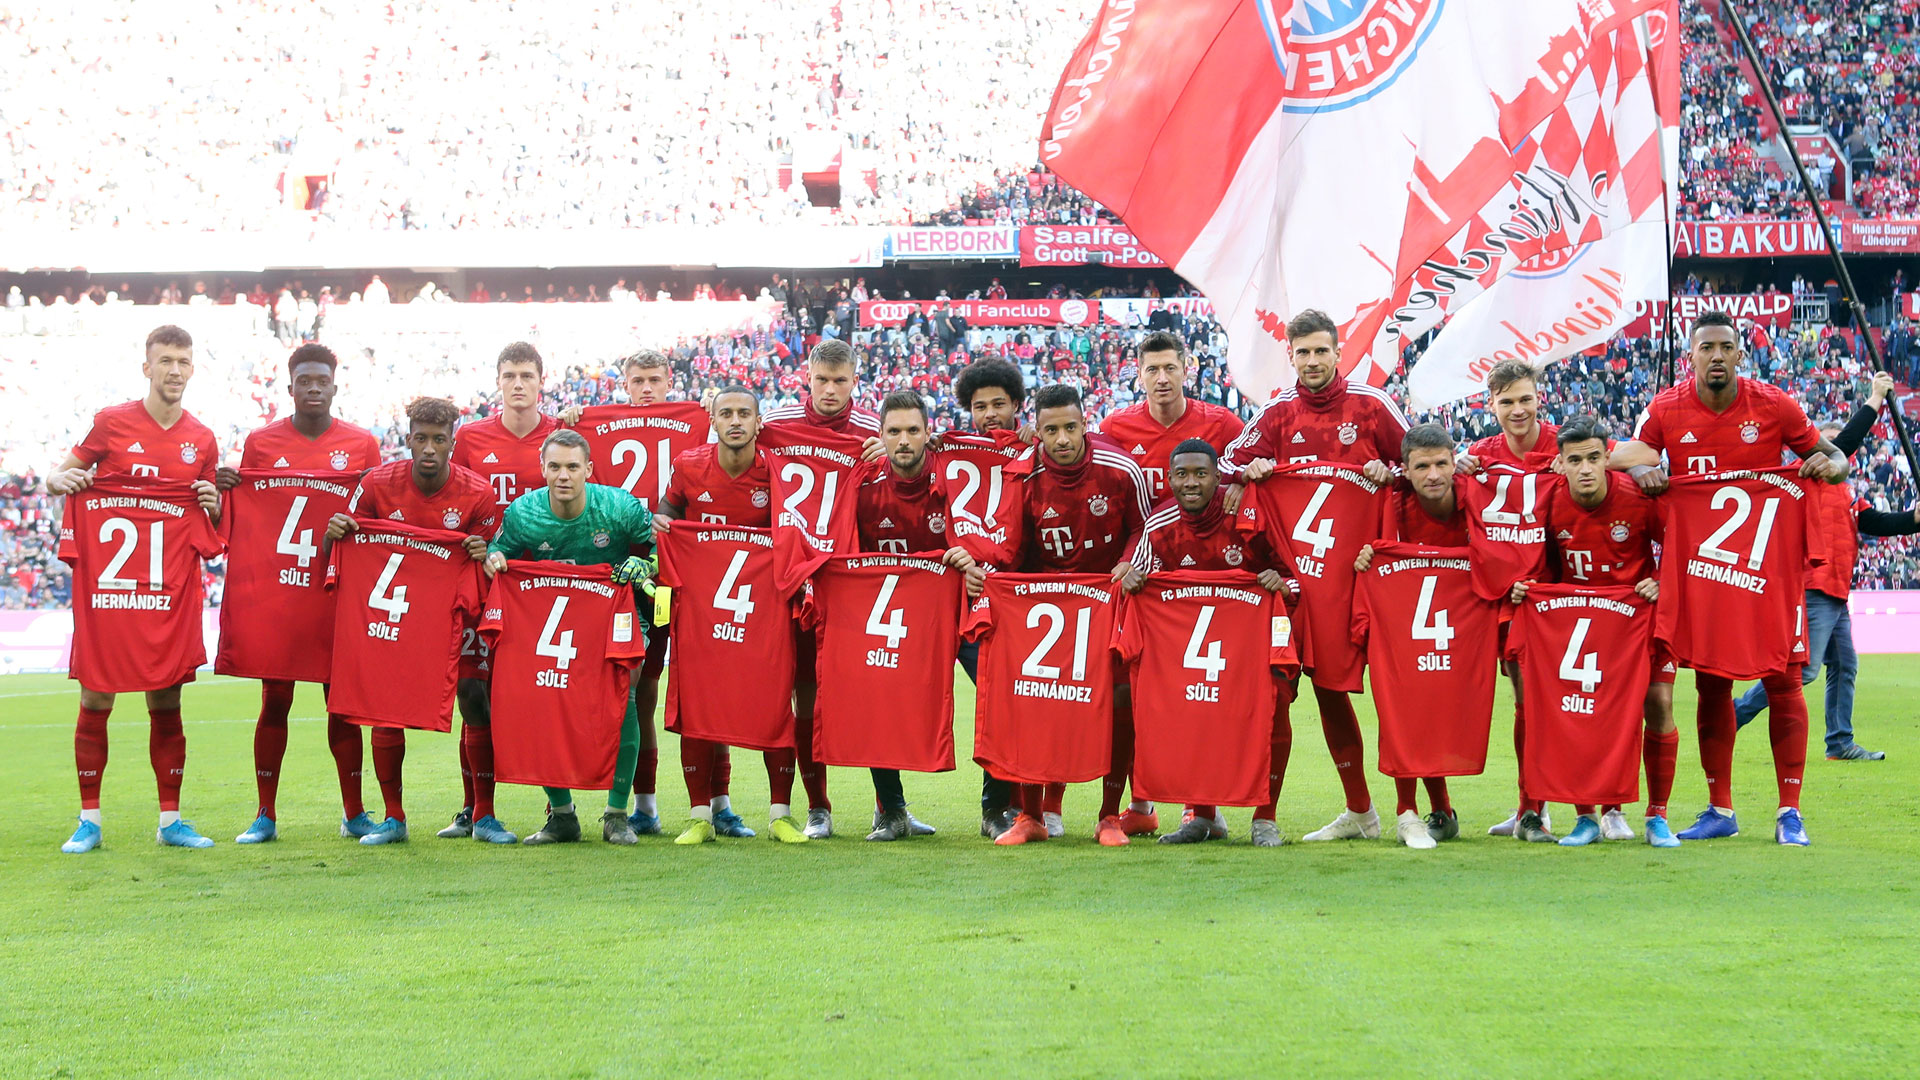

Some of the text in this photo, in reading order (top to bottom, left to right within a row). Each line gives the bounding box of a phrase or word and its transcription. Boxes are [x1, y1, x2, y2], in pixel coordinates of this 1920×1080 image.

[1704, 224, 1825, 254] BAKUM
[1852, 223, 1918, 236] Hanse Bayern
[1862, 234, 1908, 246] Lüneburg
[898, 230, 1008, 252] HERBORN
[1034, 244, 1164, 264] Grottn-Pow
[978, 304, 1050, 318] Fanclub
[596, 416, 691, 436] FC BAYERN MÜNCHEN
[814, 446, 856, 468] MÜNCHEN
[611, 438, 670, 511] 21
[1336, 466, 1378, 495] MÜNCHEN
[254, 478, 350, 498] FC BAYERN MÜNCHEN
[490, 474, 516, 504] T
[946, 460, 1003, 529] 21
[1759, 472, 1804, 500] MÜNCHEN
[86, 497, 185, 518] FC BAYERN MÜNCHEN
[780, 462, 839, 536] 21
[1292, 482, 1336, 559] 4
[1698, 486, 1780, 572] 21
[276, 496, 318, 568] 4
[697, 531, 774, 548] FC BAYERN MÜNC
[1041, 526, 1074, 558] T
[1486, 526, 1546, 544] ERNÁNDEZ
[98, 517, 164, 592] 21
[355, 533, 452, 560] FC BAYERN MÜNCHEN
[847, 557, 946, 576] FC BAYERN MÜNCHEN
[1295, 556, 1325, 578] SÜLE
[1378, 558, 1472, 577] FC BAYERN MÜNCHE
[1566, 550, 1593, 581] T
[279, 568, 311, 588] SÜLE
[368, 552, 410, 624] 4
[520, 577, 615, 599] FC BAYERN MÜNCHEN
[712, 550, 756, 624] 4
[1687, 559, 1767, 595] HERNÁNDEZ
[92, 590, 172, 612] HERNÁNDEZ
[1014, 582, 1112, 604] FC BAYERN MÜNCHEN
[1162, 586, 1262, 606] FC BAYERN MÜNCHEN
[866, 574, 908, 648] 4
[1412, 576, 1454, 650] 4
[1536, 596, 1636, 618] FC BAYERN MÜNCHEN
[368, 622, 400, 642] SÜLE
[536, 596, 578, 670] 4
[712, 622, 746, 643] SÜLE
[1022, 602, 1092, 682] 21
[1183, 605, 1226, 682] 4
[866, 648, 900, 668] SÜLE
[1418, 652, 1451, 672] SÜLE
[1559, 618, 1602, 694] 4
[536, 669, 568, 690] SÜLE
[1014, 680, 1092, 703] HERNÁNDEZ
[1185, 684, 1220, 703] SÜLE
[1561, 694, 1594, 714] SÜLE
